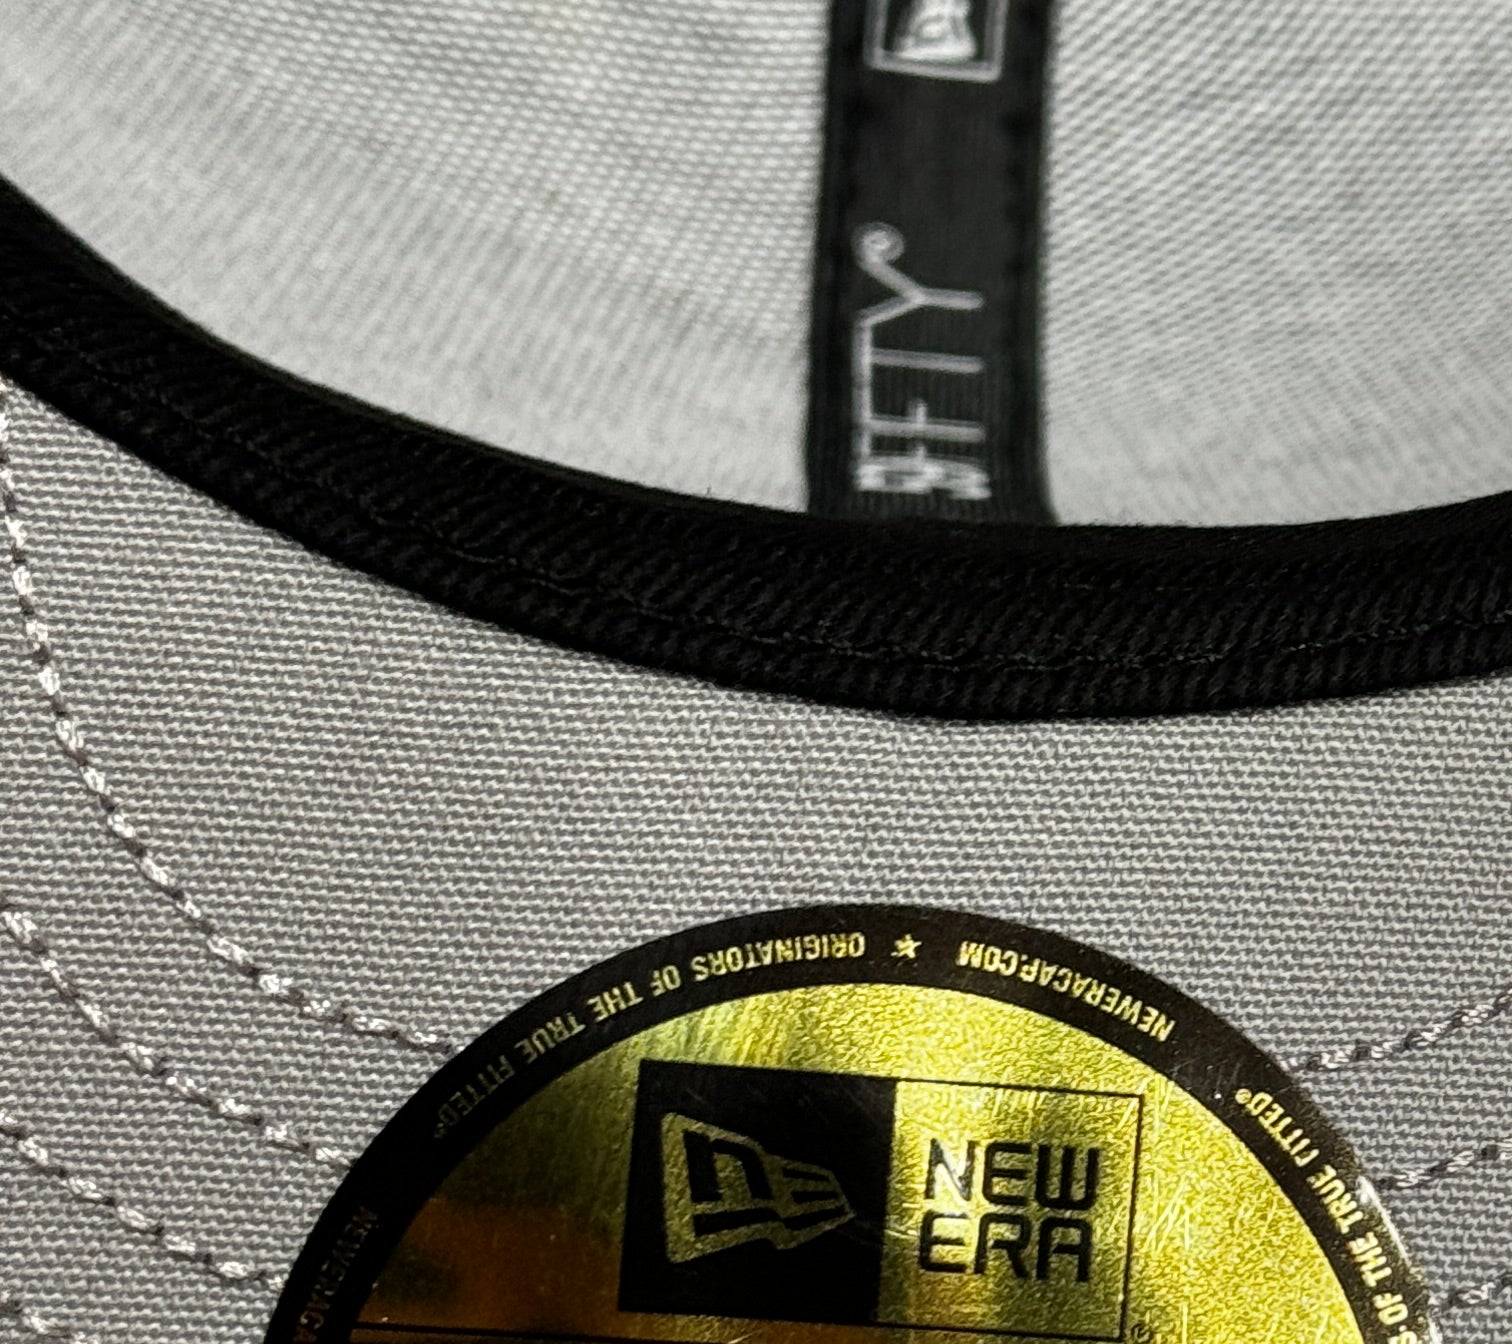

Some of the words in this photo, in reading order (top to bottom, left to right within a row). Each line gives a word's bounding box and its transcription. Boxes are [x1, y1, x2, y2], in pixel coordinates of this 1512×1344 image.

[651, 964, 682, 997] OF
[692, 932, 867, 982] ORIGINATORS
[586, 981, 645, 1024] THE
[955, 940, 1176, 1042] NEWERACAP.COM
[514, 1011, 587, 1064] TRUE
[923, 1137, 1101, 1211] NEW
[1307, 1165, 1367, 1235] TRUE
[917, 1212, 1094, 1284] ERA
[1350, 1230, 1393, 1288] THE
[1379, 1293, 1409, 1327] OF
